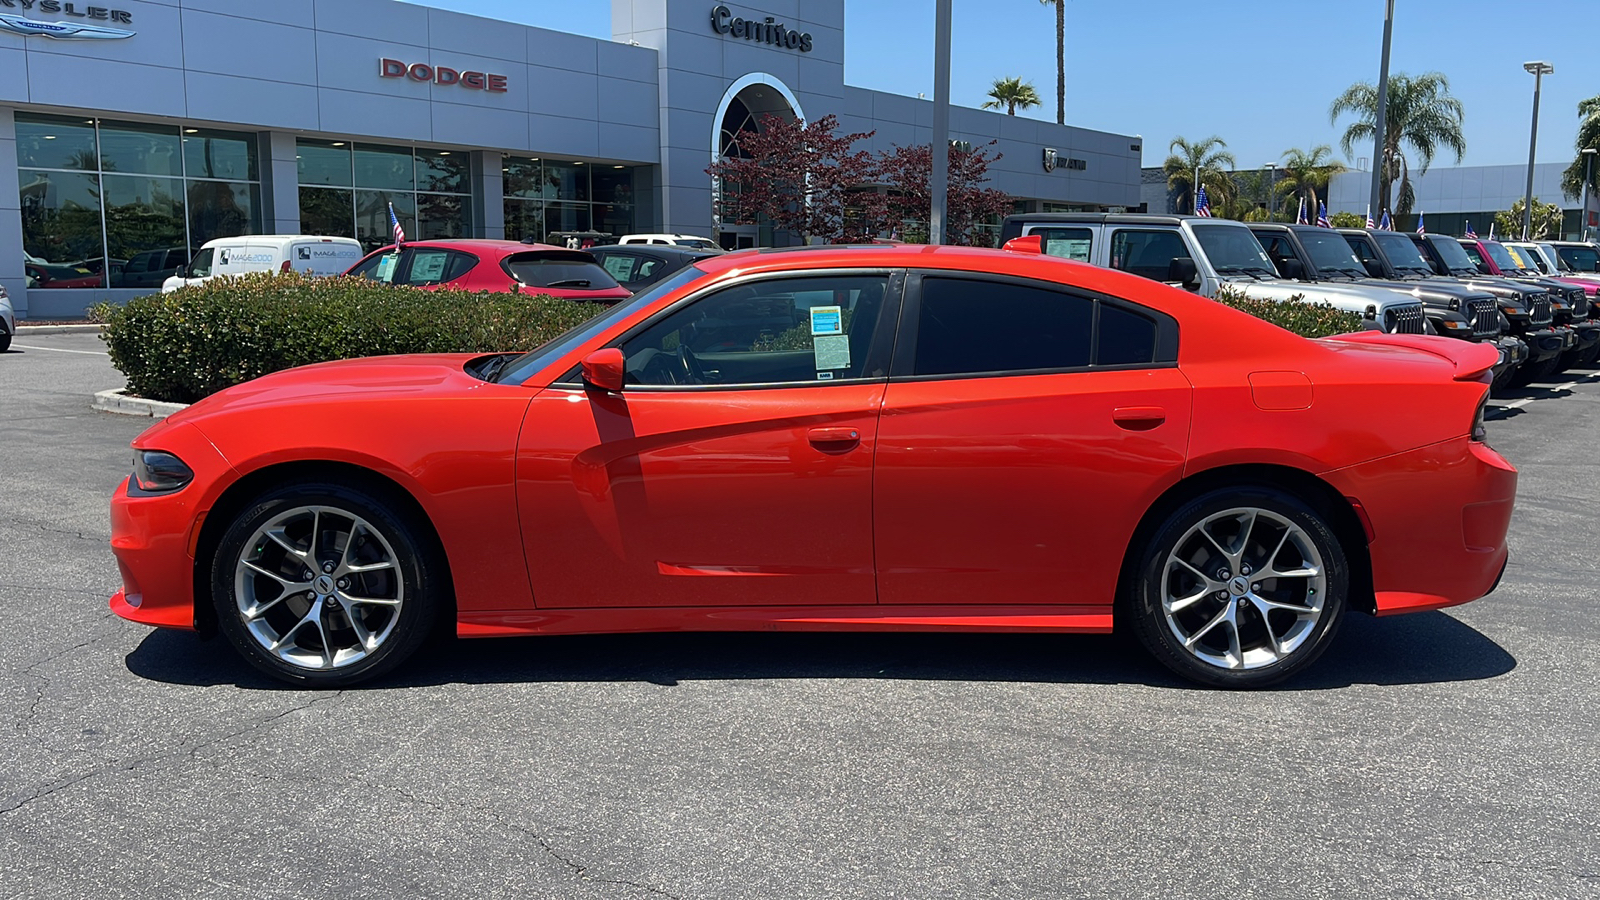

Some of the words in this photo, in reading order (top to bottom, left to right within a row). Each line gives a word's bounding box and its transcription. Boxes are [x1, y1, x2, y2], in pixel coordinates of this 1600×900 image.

[711, 5, 813, 52] Cerritos
[379, 57, 508, 92] DODGE
[1056, 157, 1087, 171] RAM
